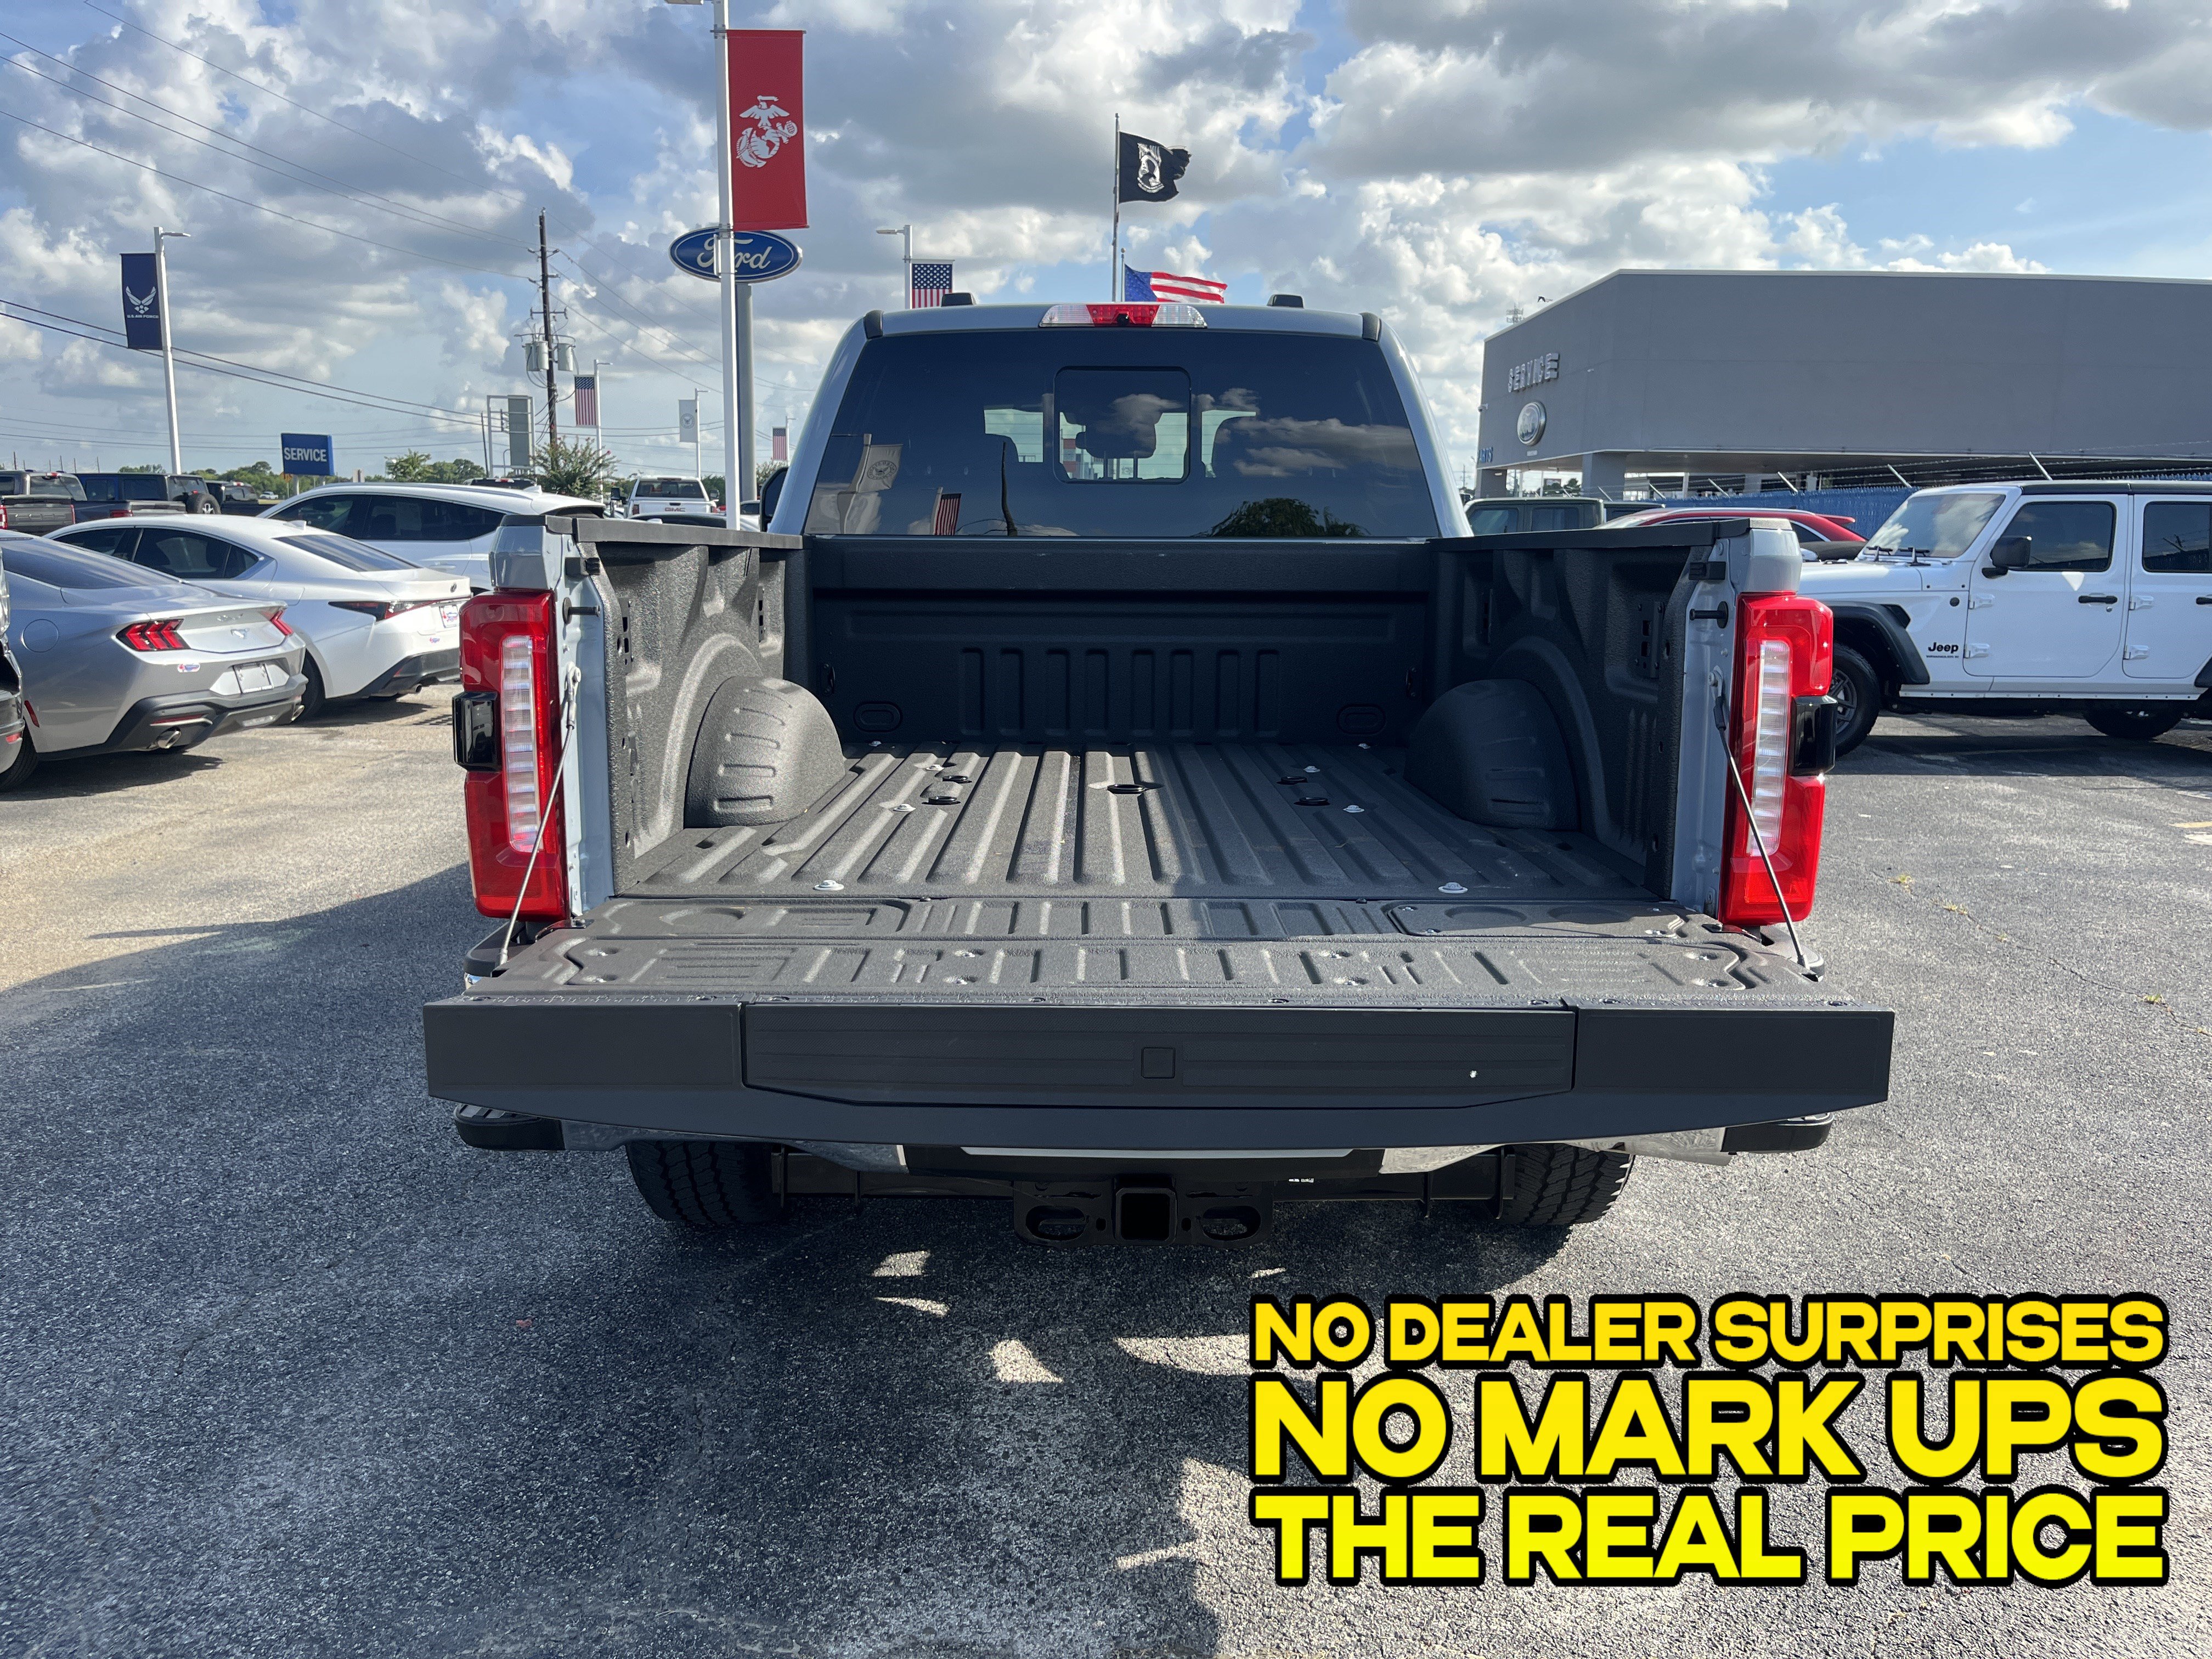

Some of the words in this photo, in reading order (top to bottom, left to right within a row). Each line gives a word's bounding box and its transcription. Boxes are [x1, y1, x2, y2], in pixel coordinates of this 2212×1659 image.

[696, 236, 773, 269] Frd
[1508, 353, 1560, 393] SERVICE
[284, 447, 328, 462] SERVICE
[1928, 642, 1959, 654] Jeep
